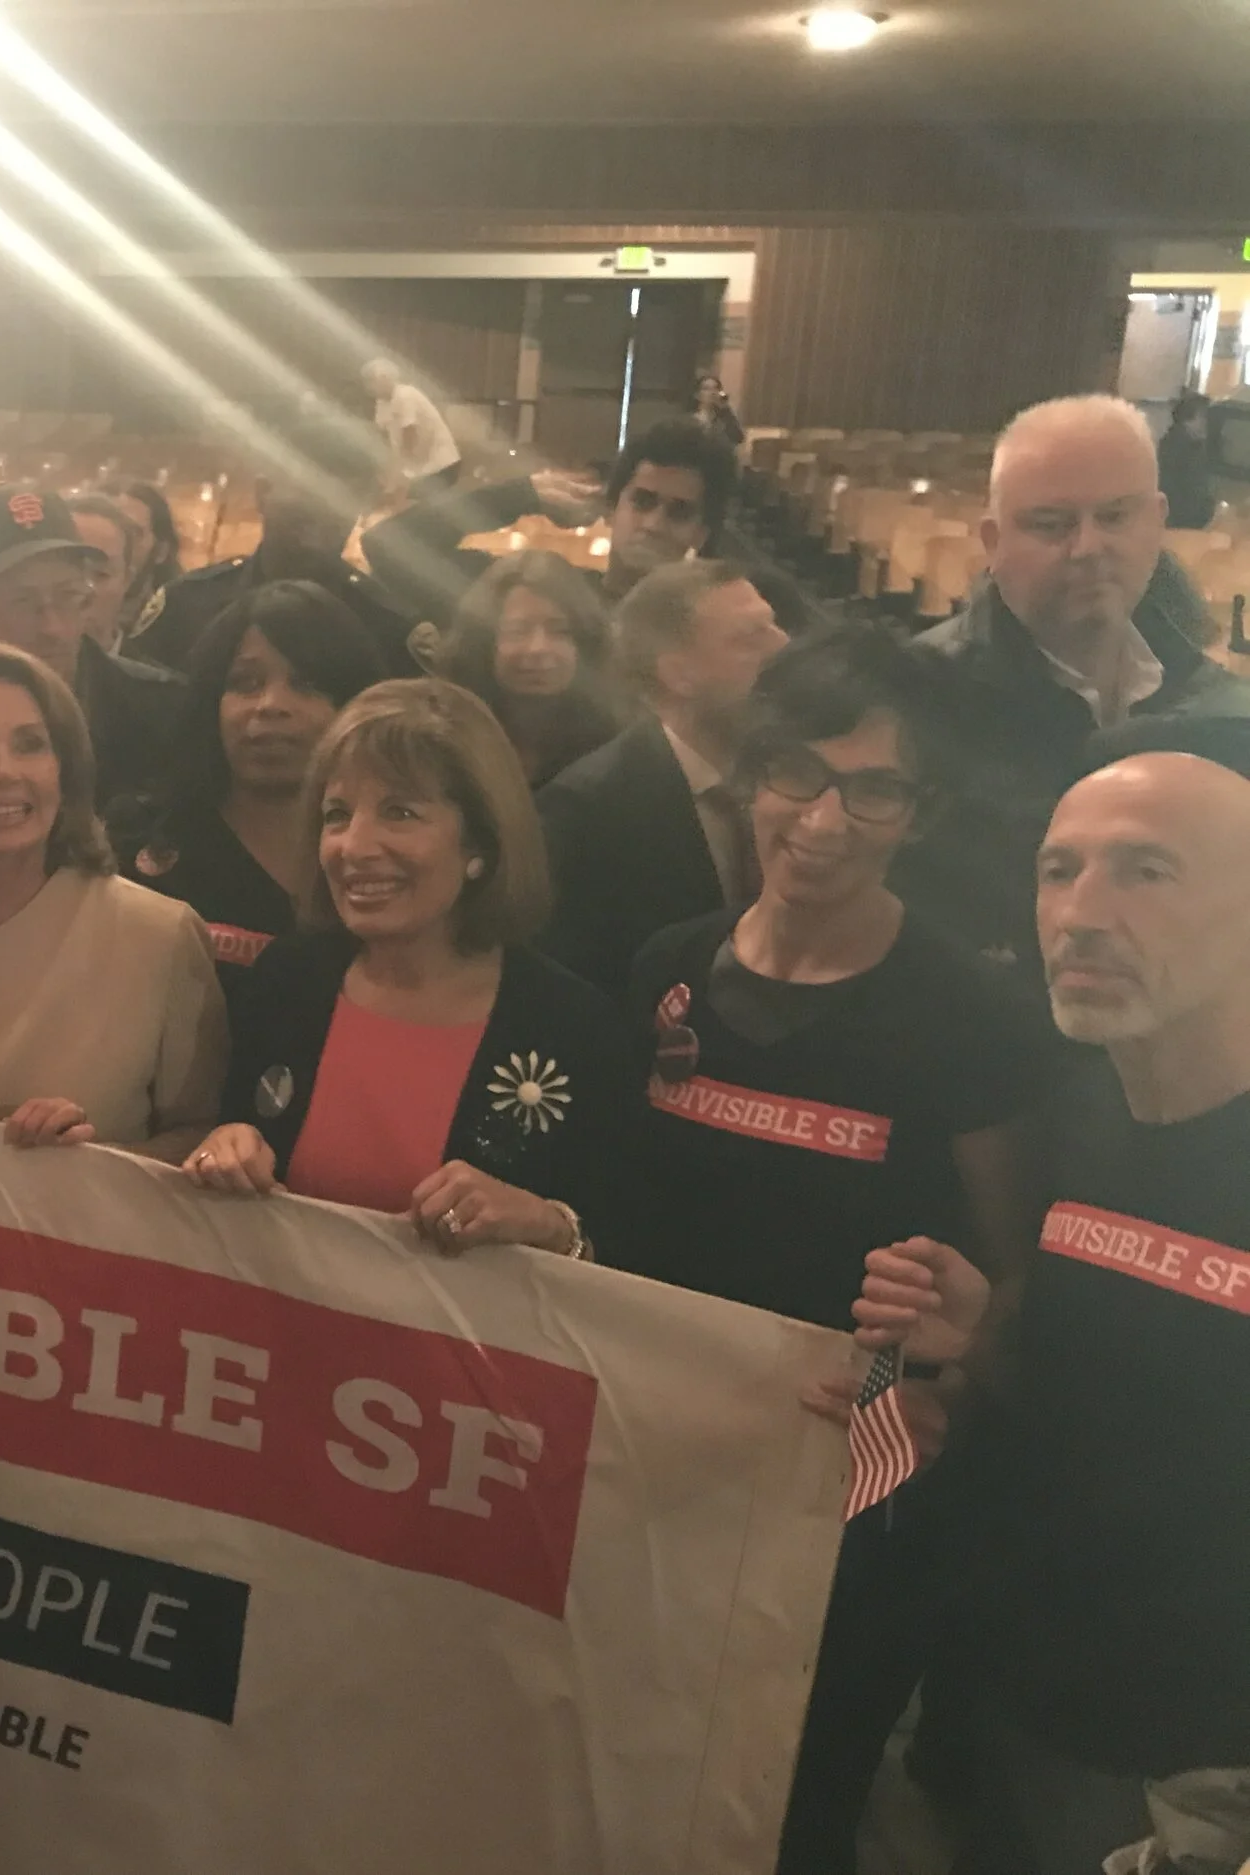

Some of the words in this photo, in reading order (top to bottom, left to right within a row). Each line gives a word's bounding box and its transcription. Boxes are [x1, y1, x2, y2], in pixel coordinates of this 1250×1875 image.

[824, 1116, 876, 1151] SF
[1194, 1254, 1250, 1298] SF
[324, 1377, 545, 1518] SF
